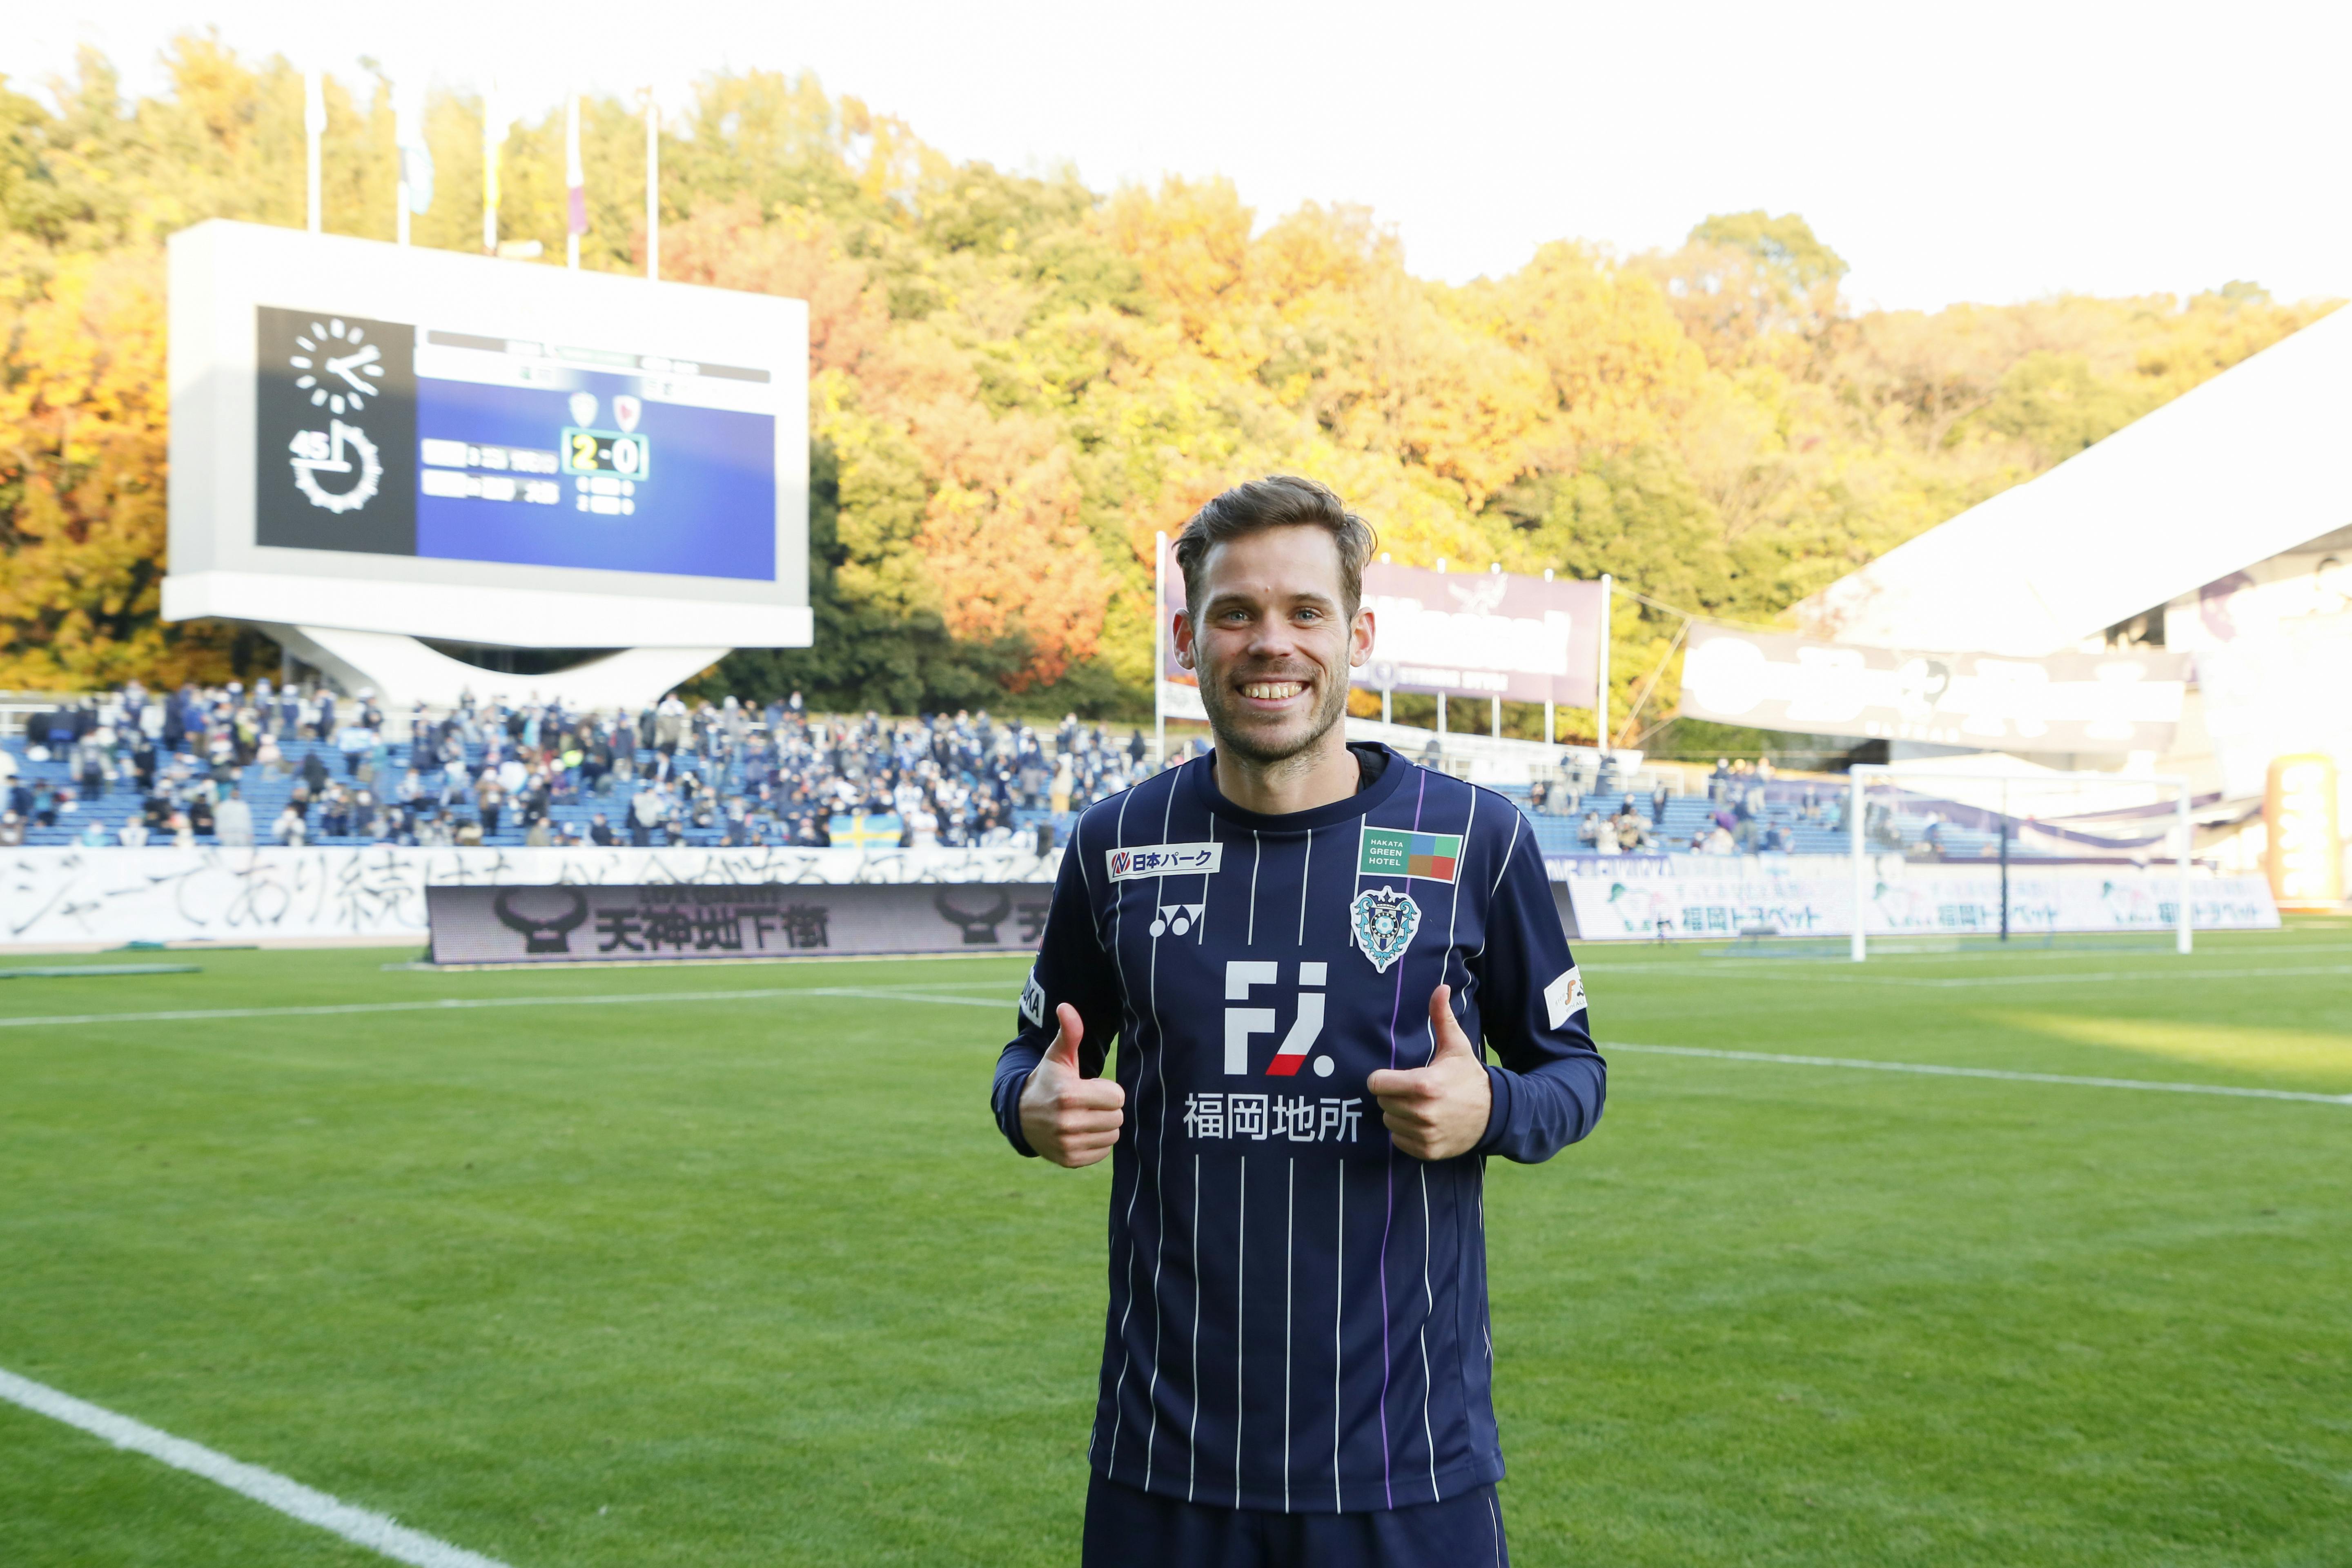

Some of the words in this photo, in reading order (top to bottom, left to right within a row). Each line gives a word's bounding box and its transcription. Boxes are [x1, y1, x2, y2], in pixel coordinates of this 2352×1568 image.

[1371, 839, 1403, 848] HAKATA
[1370, 848, 1402, 857] GREEN
[1133, 850, 1212, 872] 日本パーク
[1369, 857, 1401, 866] HOTEL
[1374, 913, 1396, 922] AVISPA
[1372, 926, 1397, 938] FUKUOKA
[1183, 1093, 1363, 1143] 福岡地所
